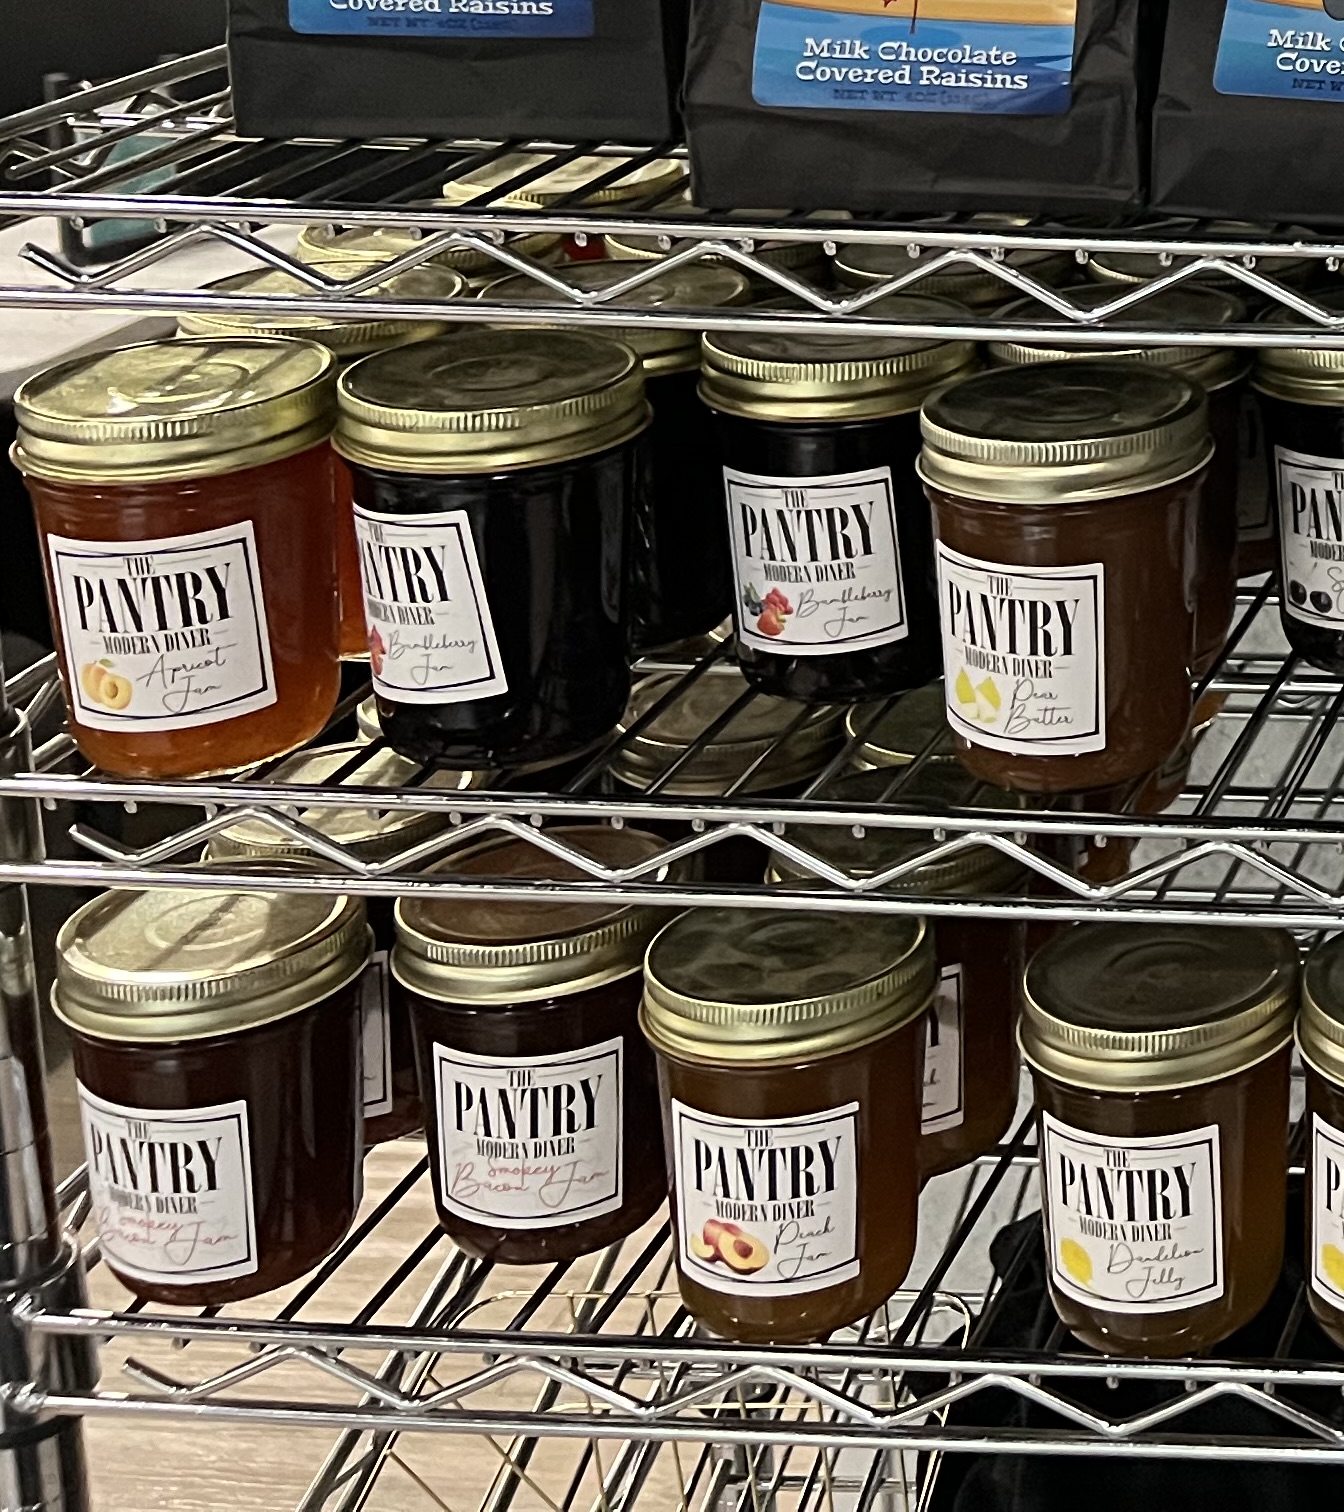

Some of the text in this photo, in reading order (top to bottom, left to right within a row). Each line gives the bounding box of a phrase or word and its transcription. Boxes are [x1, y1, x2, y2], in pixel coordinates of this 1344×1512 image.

[803, 37, 1018, 67] Milk Chocolate
[740, 500, 875, 562] PANTRY
[72, 562, 234, 634] PANTRY
[948, 579, 1080, 657] PANTRY
[136, 643, 238, 689] Apricot
[162, 674, 222, 714] Jam
[1010, 678, 1059, 711] Pear
[1003, 703, 1075, 735] Butter
[453, 1073, 604, 1140] PANTRY
[450, 1160, 610, 1209] Bacon Jam
[693, 1135, 843, 1202] PANTRY
[1058, 1151, 1197, 1223] PANTRY
[773, 1215, 836, 1255] Peach
[776, 1242, 832, 1280] Jam
[1125, 1266, 1186, 1299] Jelly
